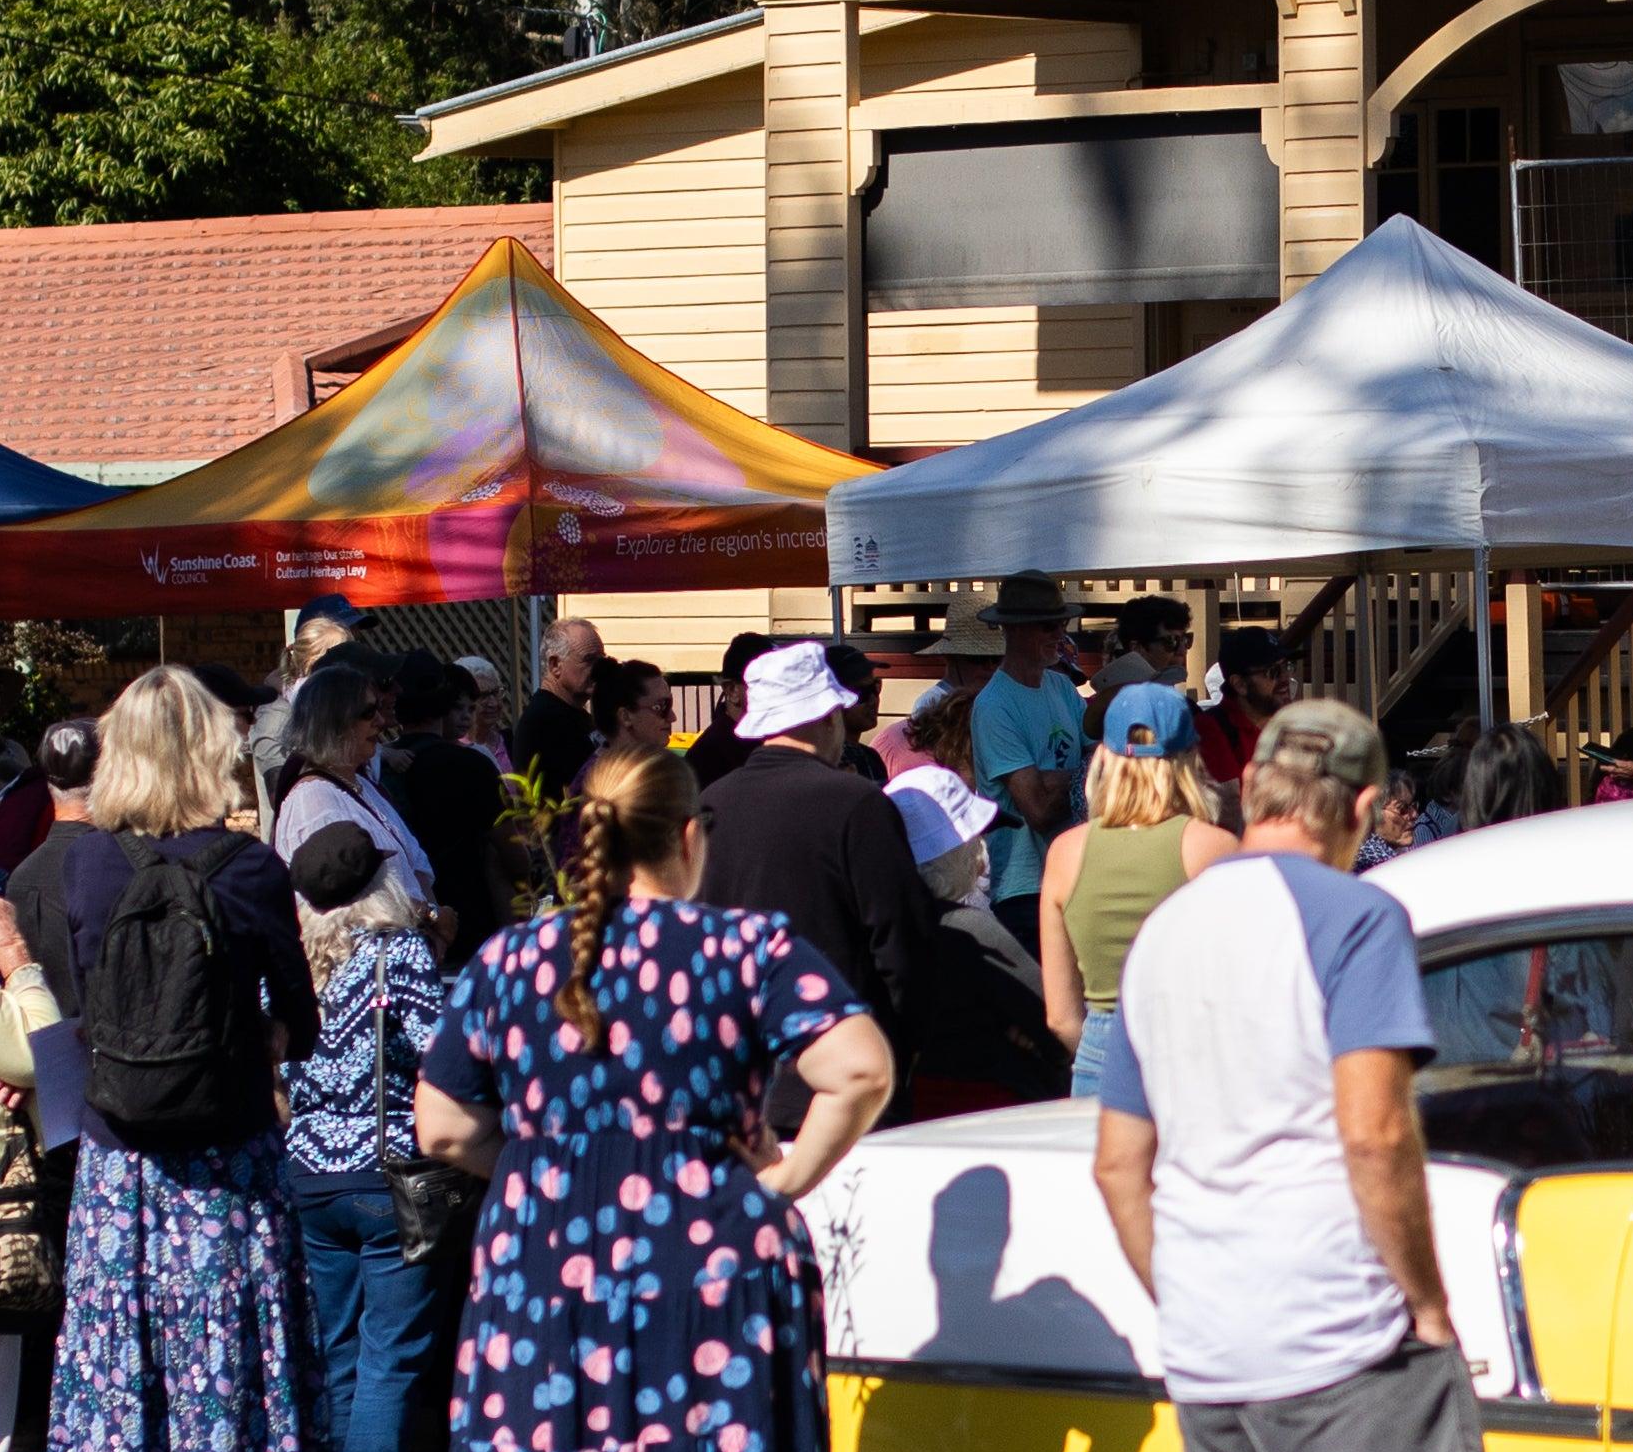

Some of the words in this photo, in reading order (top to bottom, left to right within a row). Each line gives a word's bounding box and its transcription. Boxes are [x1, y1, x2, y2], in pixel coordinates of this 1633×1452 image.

[616, 533, 676, 561] Explore
[680, 531, 706, 554] the
[710, 529, 773, 558] region's
[170, 555, 222, 571] Sunshine
[223, 553, 257, 569] Coast
[276, 550, 291, 562] Our
[292, 550, 323, 563] heritage
[323, 549, 338, 561] Our
[339, 548, 365, 560] stories
[171, 572, 208, 584] COUNCIL
[276, 567, 309, 579] Cultural
[310, 566, 346, 580] Heritage
[347, 564, 367, 580] Levy
